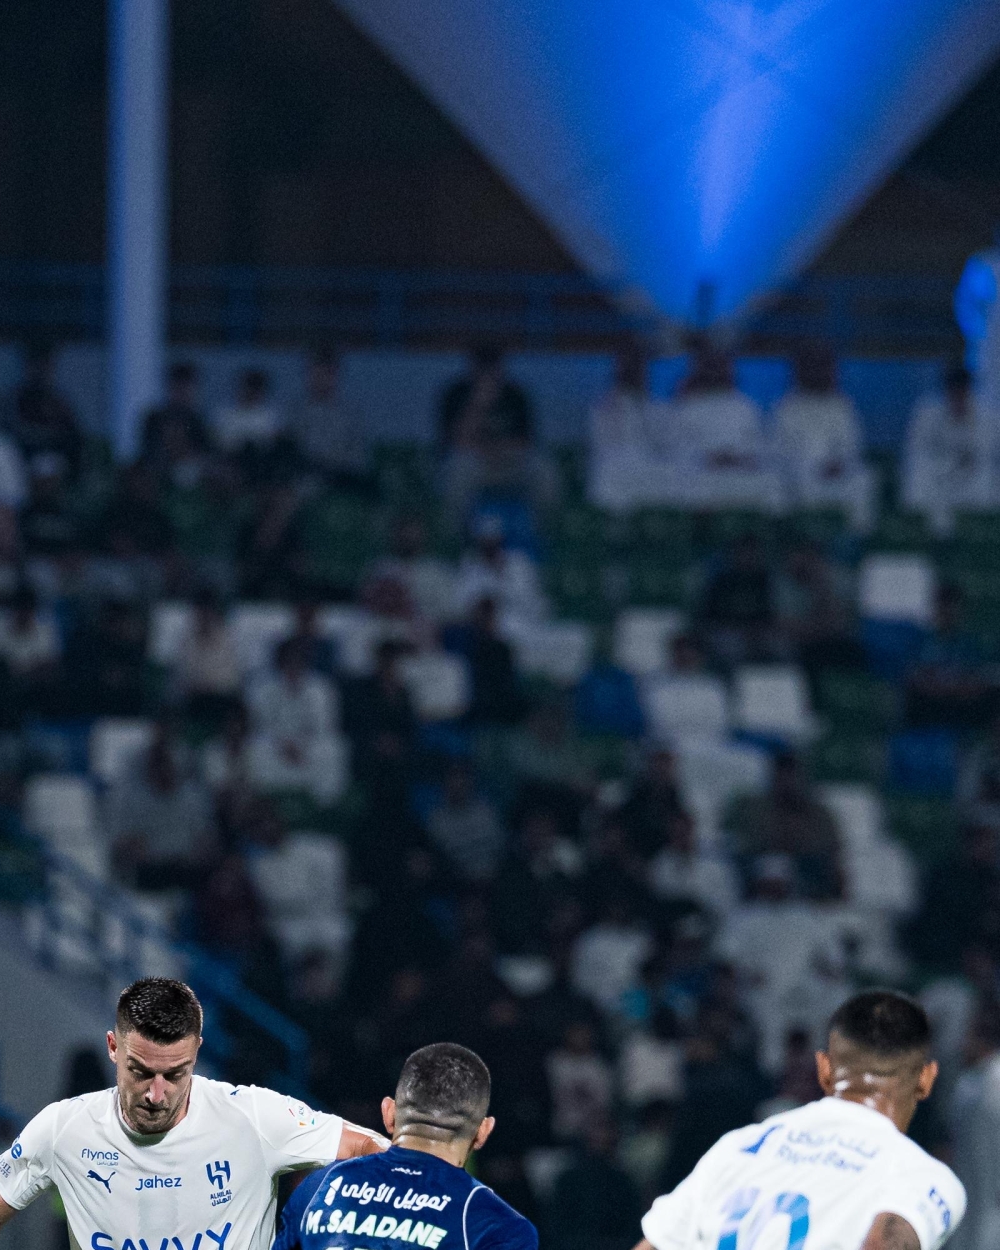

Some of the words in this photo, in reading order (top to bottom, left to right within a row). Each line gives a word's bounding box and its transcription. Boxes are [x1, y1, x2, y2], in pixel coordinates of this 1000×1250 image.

[81, 1148, 119, 1161] flynas
[135, 1175, 182, 1191] jahez
[341, 1181, 396, 1205] الأولى
[393, 1188, 452, 1212] تمويل
[306, 1209, 448, 1250] M.SAADANE
